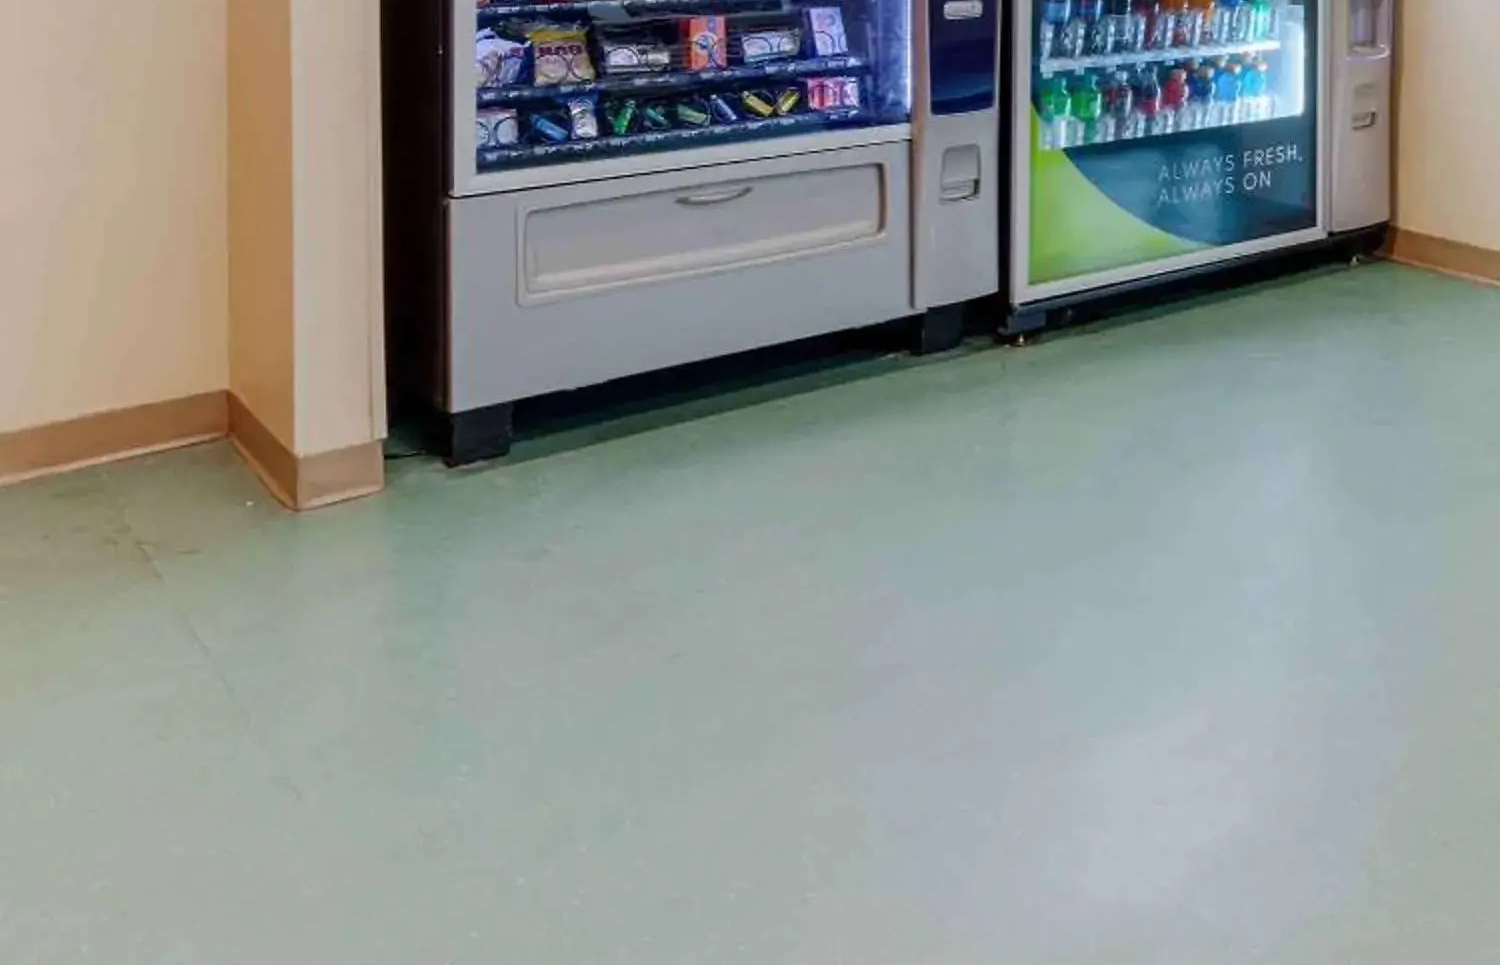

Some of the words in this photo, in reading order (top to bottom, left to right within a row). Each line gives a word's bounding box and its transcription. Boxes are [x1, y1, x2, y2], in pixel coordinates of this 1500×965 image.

[1158, 154, 1234, 181] ALWAYS
[1158, 176, 1234, 204] ALWAYS
[1243, 170, 1271, 190] ON
